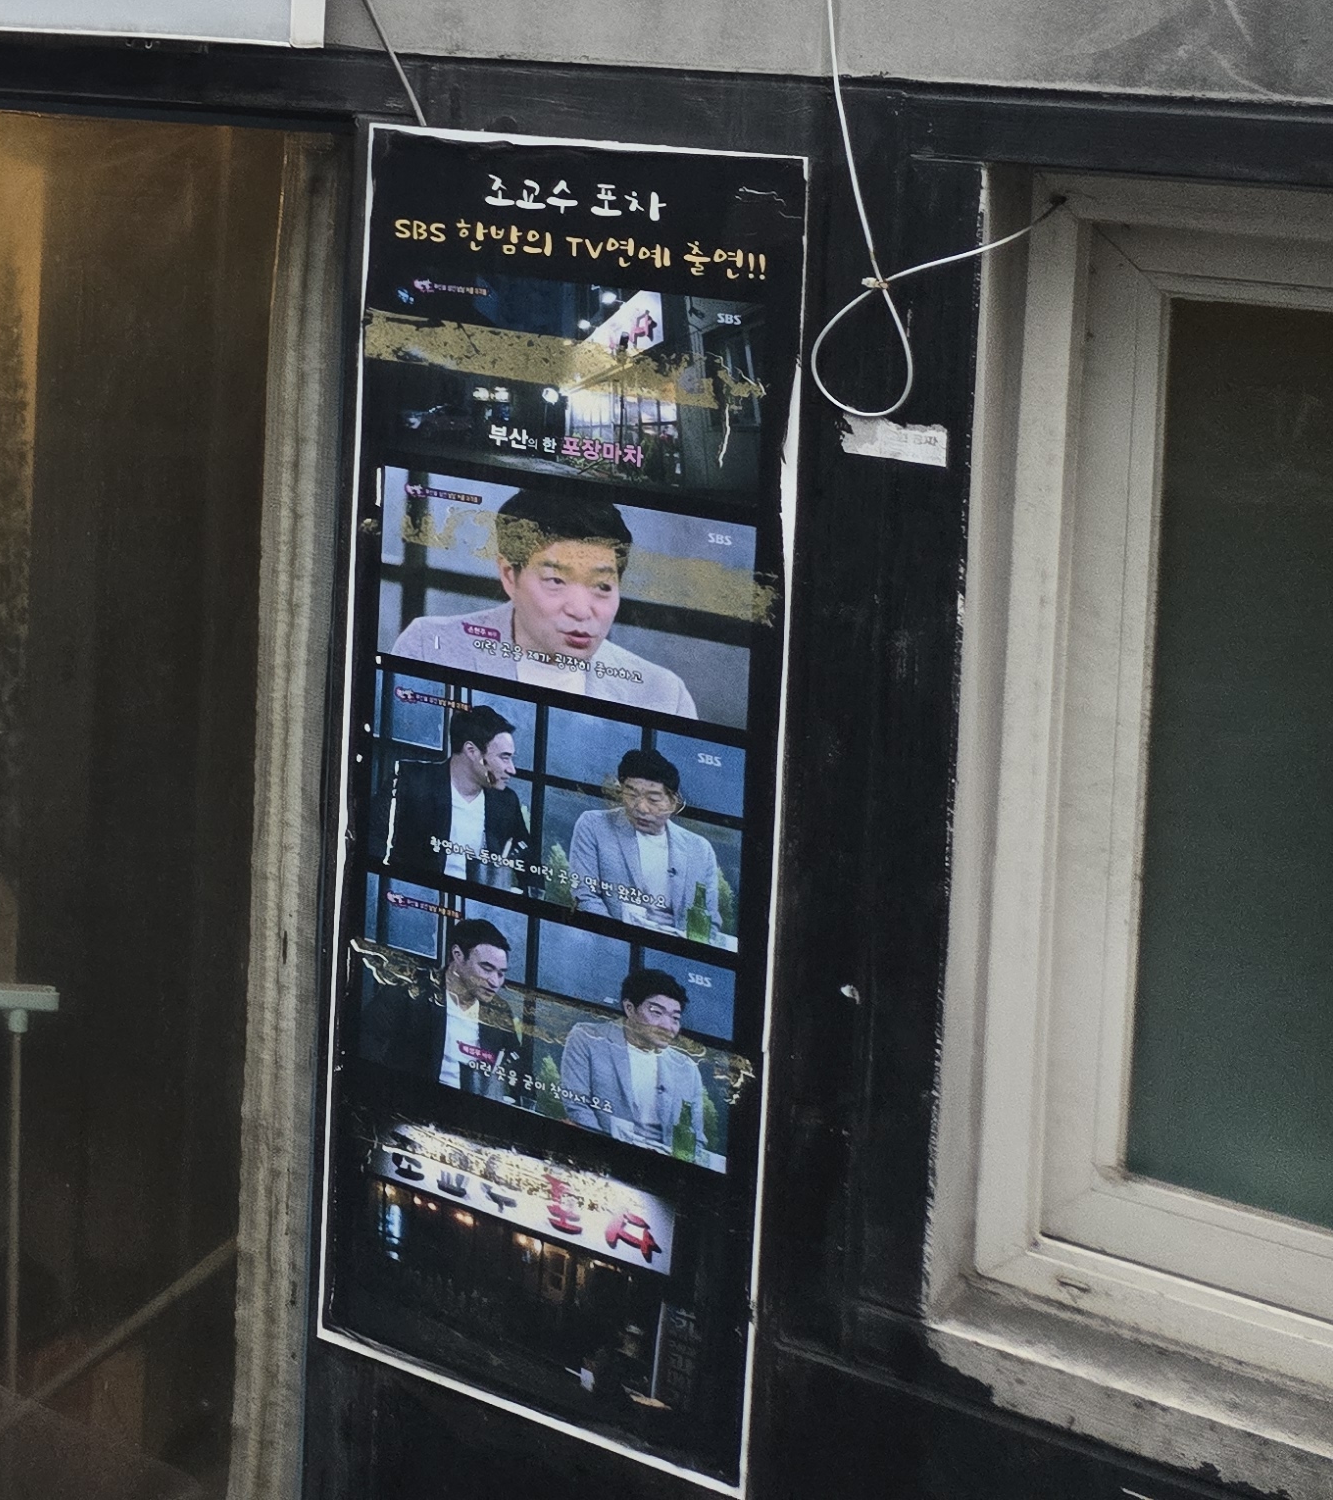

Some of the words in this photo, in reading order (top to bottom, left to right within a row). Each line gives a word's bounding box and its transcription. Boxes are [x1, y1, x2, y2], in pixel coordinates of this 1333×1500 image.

[485, 173, 578, 214] 조교수
[591, 183, 666, 221] 포차
[394, 219, 446, 243] SBS
[455, 219, 553, 256] 한밤의
[566, 236, 670, 269] TV연예
[683, 241, 766, 280] 출연!!
[717, 312, 742, 326] SBS
[488, 424, 538, 450] 부산의
[542, 436, 557, 454] 한
[560, 436, 644, 468] 포장마차
[707, 531, 732, 547] SBS
[473, 639, 498, 656] 이런
[501, 642, 522, 661] 곳을
[526, 650, 551, 664] 제가
[554, 653, 590, 672] 굉장히
[594, 661, 644, 684] 좋아하고
[697, 752, 722, 768] SBS
[480, 848, 526, 873] 동안에도
[530, 865, 554, 882] 이런
[558, 870, 581, 889] 곳을
[601, 882, 614, 897] 번
[688, 972, 712, 989] SBS
[469, 1060, 492, 1077] 이런
[496, 1066, 518, 1086] 곳을
[523, 1074, 546, 1091] 굳이
[550, 1083, 586, 1103] 찾아서
